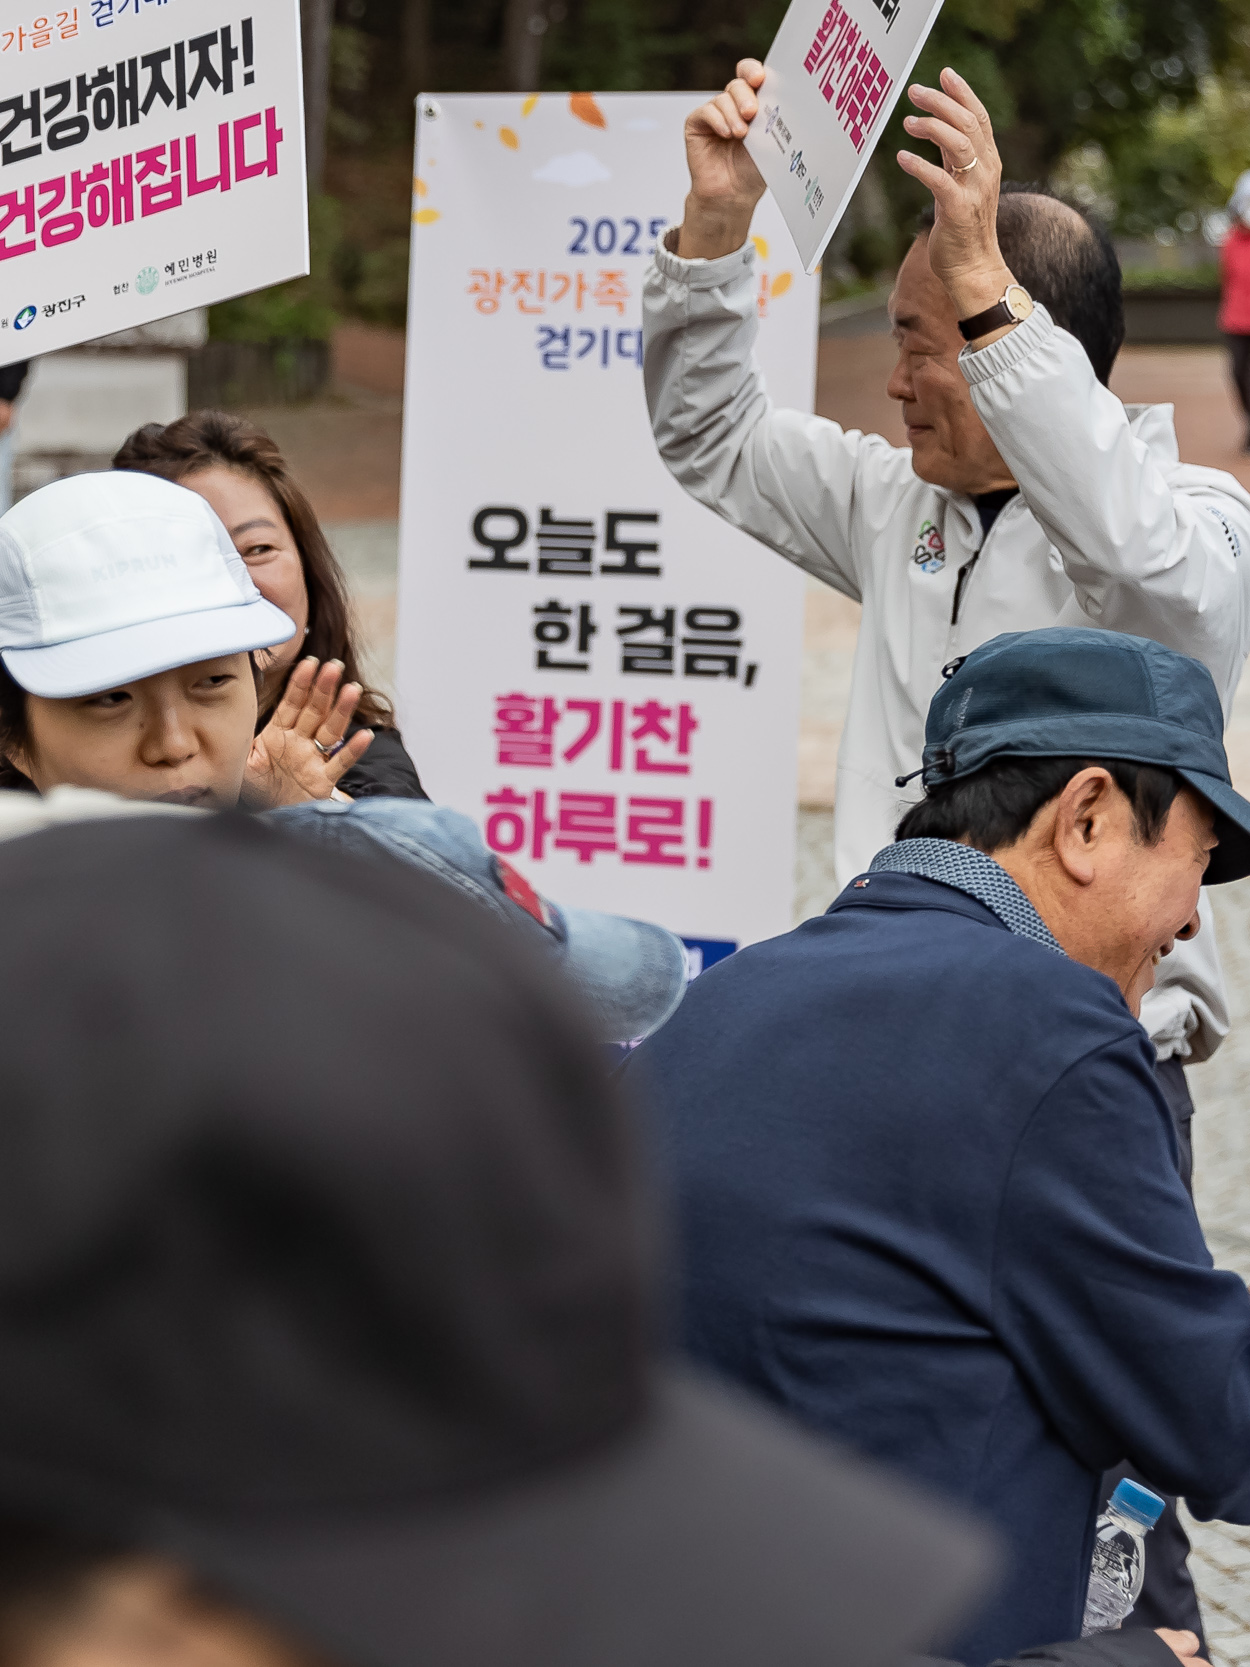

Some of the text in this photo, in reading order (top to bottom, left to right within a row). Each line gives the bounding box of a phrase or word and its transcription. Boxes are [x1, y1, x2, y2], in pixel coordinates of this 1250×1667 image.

[1, 7, 79, 51] 가을길
[0, 16, 256, 166] 건강해지자!
[0, 106, 283, 261] 건강해집니다
[41, 294, 86, 318] 광진구
[466, 269, 631, 316] 광진가족
[536, 325, 643, 370] 걷기대
[467, 505, 662, 576] 오늘도
[532, 599, 760, 688] 한 걸음,
[493, 693, 699, 775] 활기찬
[484, 787, 714, 870] 하루로!
